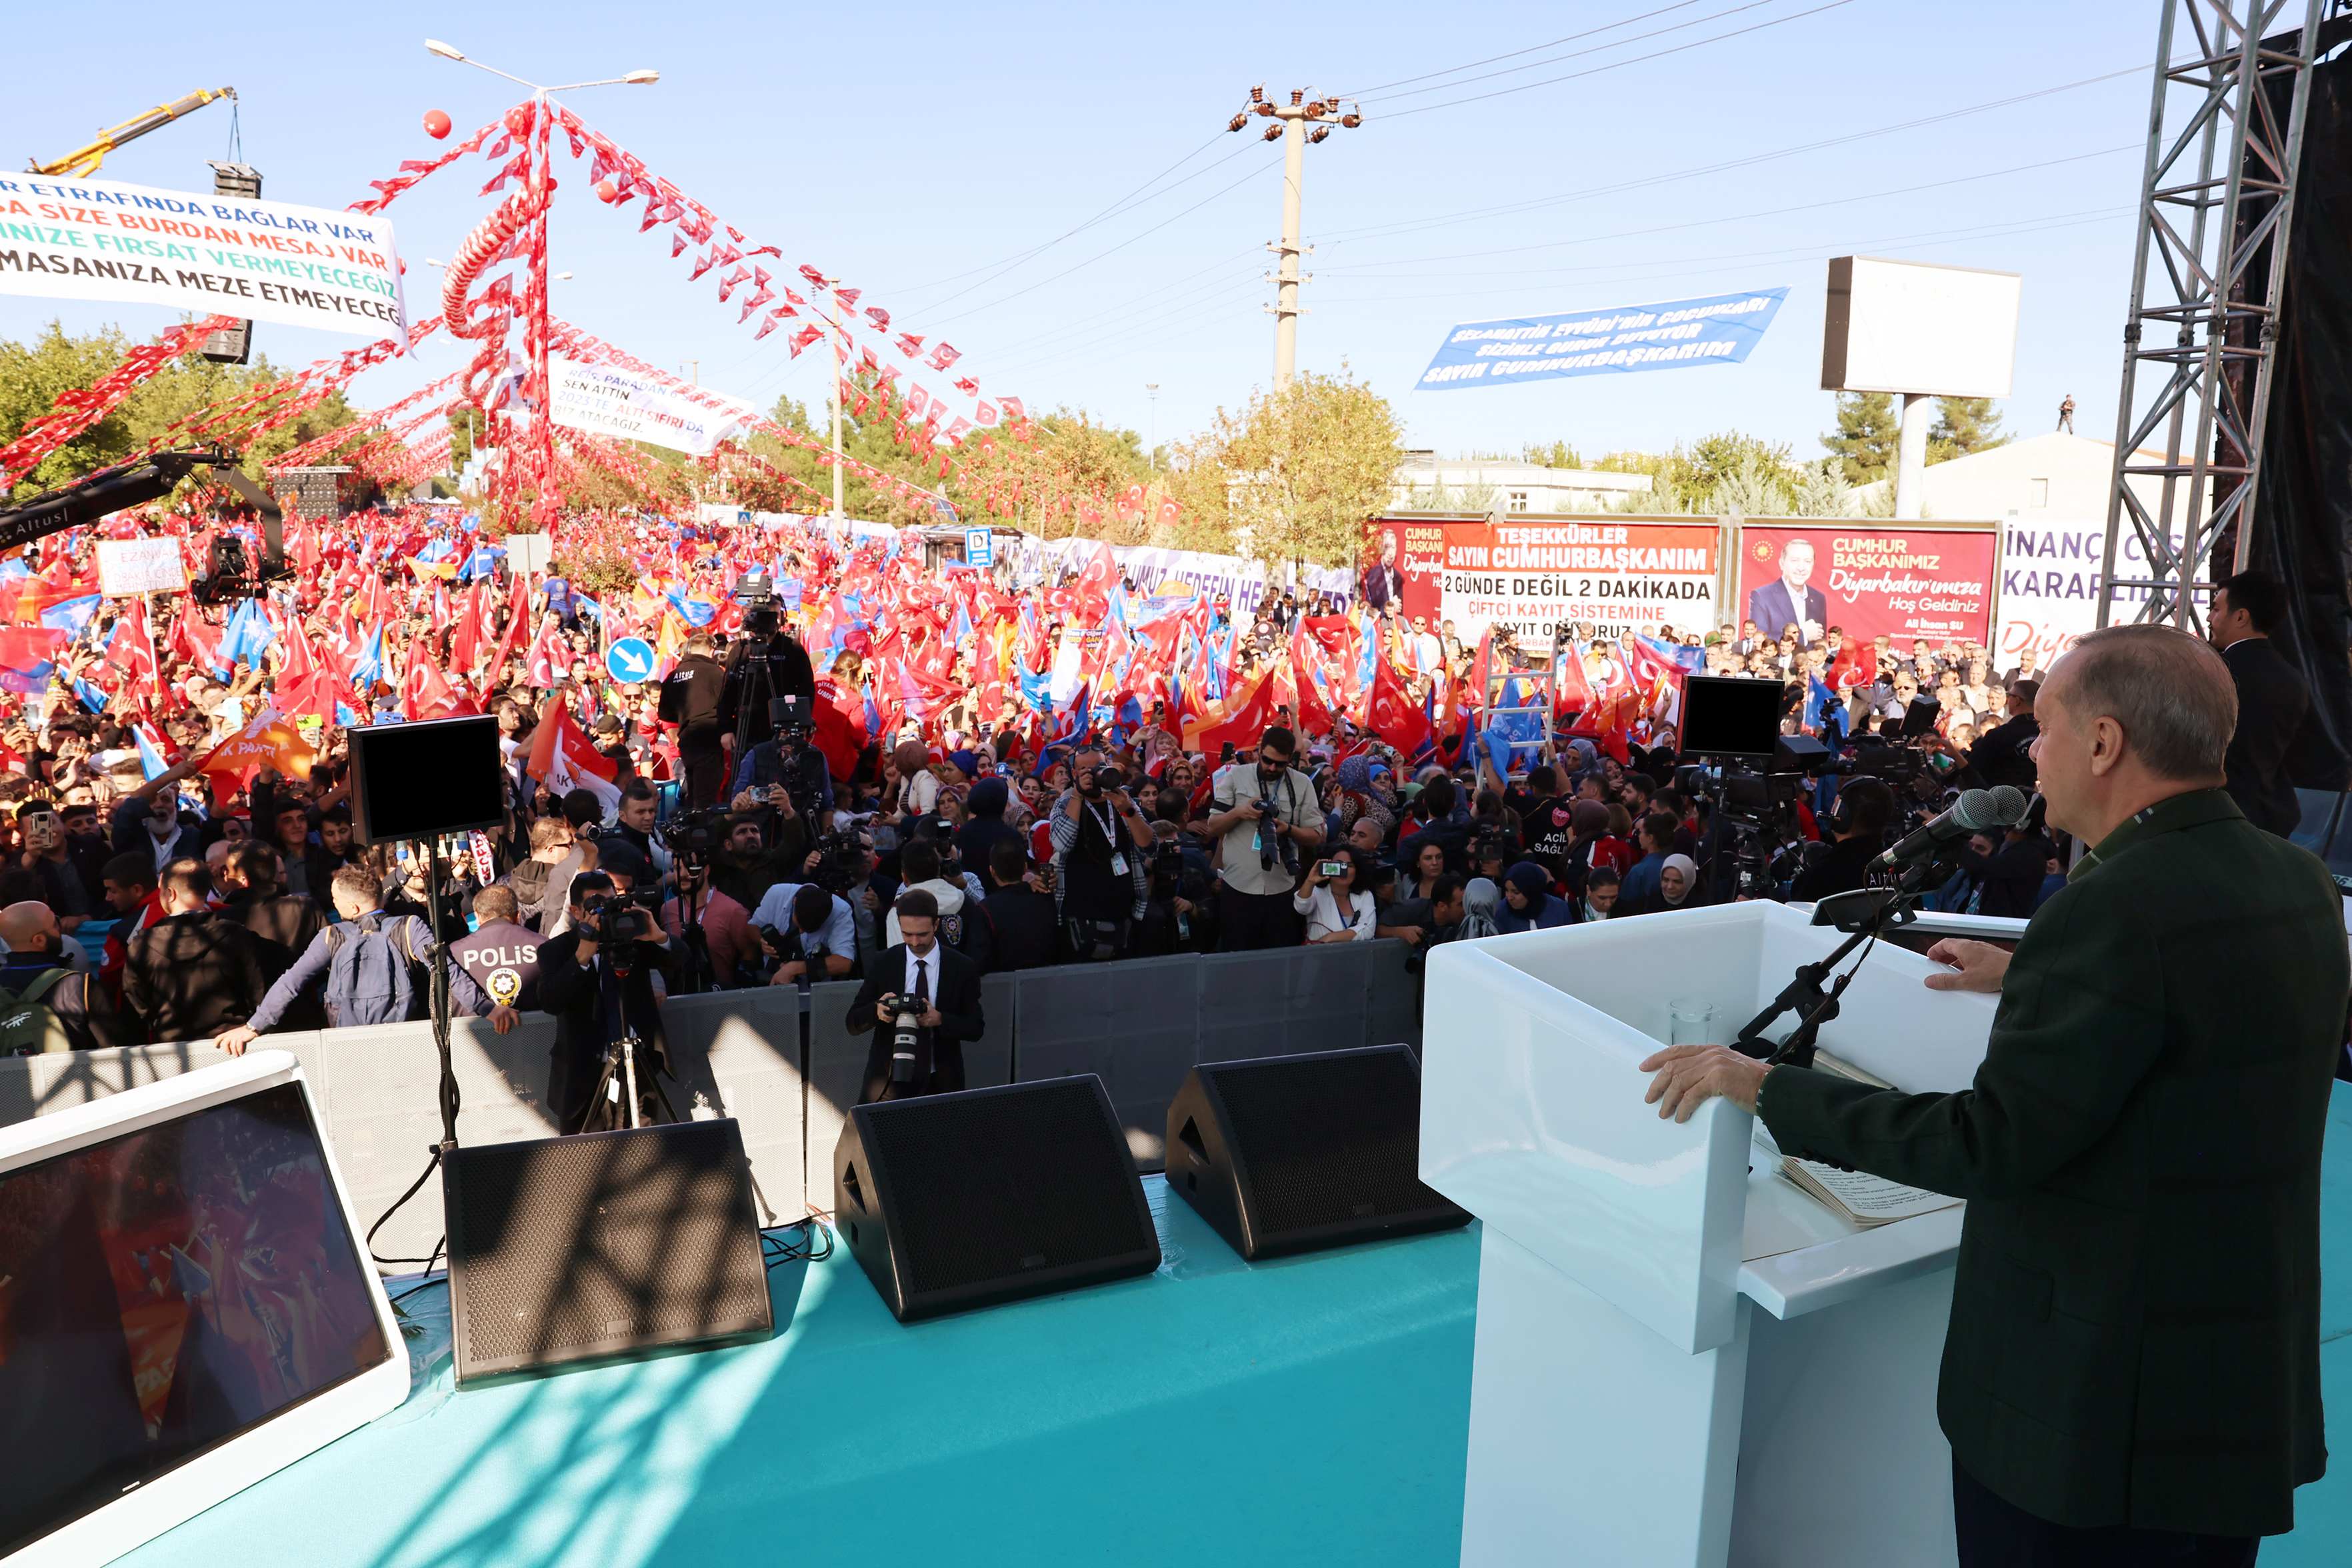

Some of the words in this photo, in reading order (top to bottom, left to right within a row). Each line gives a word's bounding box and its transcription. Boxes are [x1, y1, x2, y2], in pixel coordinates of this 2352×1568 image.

[29, 183, 207, 217] ETRAFINDA
[211, 205, 321, 235] BAĞLAR
[325, 222, 375, 244] VAR
[38, 202, 111, 226] SİZE
[117, 213, 243, 245] BURDAN
[248, 232, 335, 258] MESAJ
[339, 245, 389, 272] VAR
[0, 250, 171, 285] MASANIZA
[176, 270, 254, 297] MEZE
[93, 233, 198, 262] FIRSAT
[205, 249, 398, 301] VERMEYECEĞİZ
[1451, 323, 1553, 343] SELAHATTİN
[1609, 323, 1703, 345] DUYUYOR
[1423, 362, 1489, 383] SAYIN
[1491, 341, 1737, 375] CUMHURBAŞKANIM
[563, 379, 589, 391] SEN
[591, 385, 630, 401] ATTIN
[605, 375, 667, 395] PARADAN
[553, 405, 575, 417] BİZ
[577, 410, 643, 433] ATACAĞIZ.
[557, 391, 610, 410] 2023'TE
[615, 404, 644, 418] ALTI
[646, 411, 684, 429] SIFIRI
[686, 421, 705, 434] DA
[16, 513, 61, 535] Altus
[1405, 527, 1442, 540] CUMHUR
[973, 535, 983, 548] D
[1497, 523, 1627, 548] TEŞEKKÜRLER
[1833, 538, 1907, 553] CUMHUR
[2006, 525, 2103, 564] İNANÇ
[1449, 546, 1488, 567] SAYIN
[1492, 547, 1707, 574] CUMHURBAŞKANIM
[1833, 553, 1940, 570] BAŞKANIMIZ
[1445, 575, 1451, 592] 2
[1455, 572, 1505, 595] GÜNDE
[1513, 574, 1573, 597] DEĞİL
[1579, 579, 1591, 597] 2
[1599, 575, 1711, 600] DAKİKADA
[1469, 598, 1511, 619] ÇİFTÇİ
[1517, 603, 1565, 617] KAYIT
[1570, 601, 1665, 621] SİSTEMİNE
[1889, 596, 1916, 613] Hoş
[1919, 597, 1980, 613] Geldiniz
[1905, 619, 1919, 628] Ali
[1921, 617, 1948, 629] İhsan
[1949, 621, 1964, 630] SU
[1544, 832, 1567, 843] ACİL
